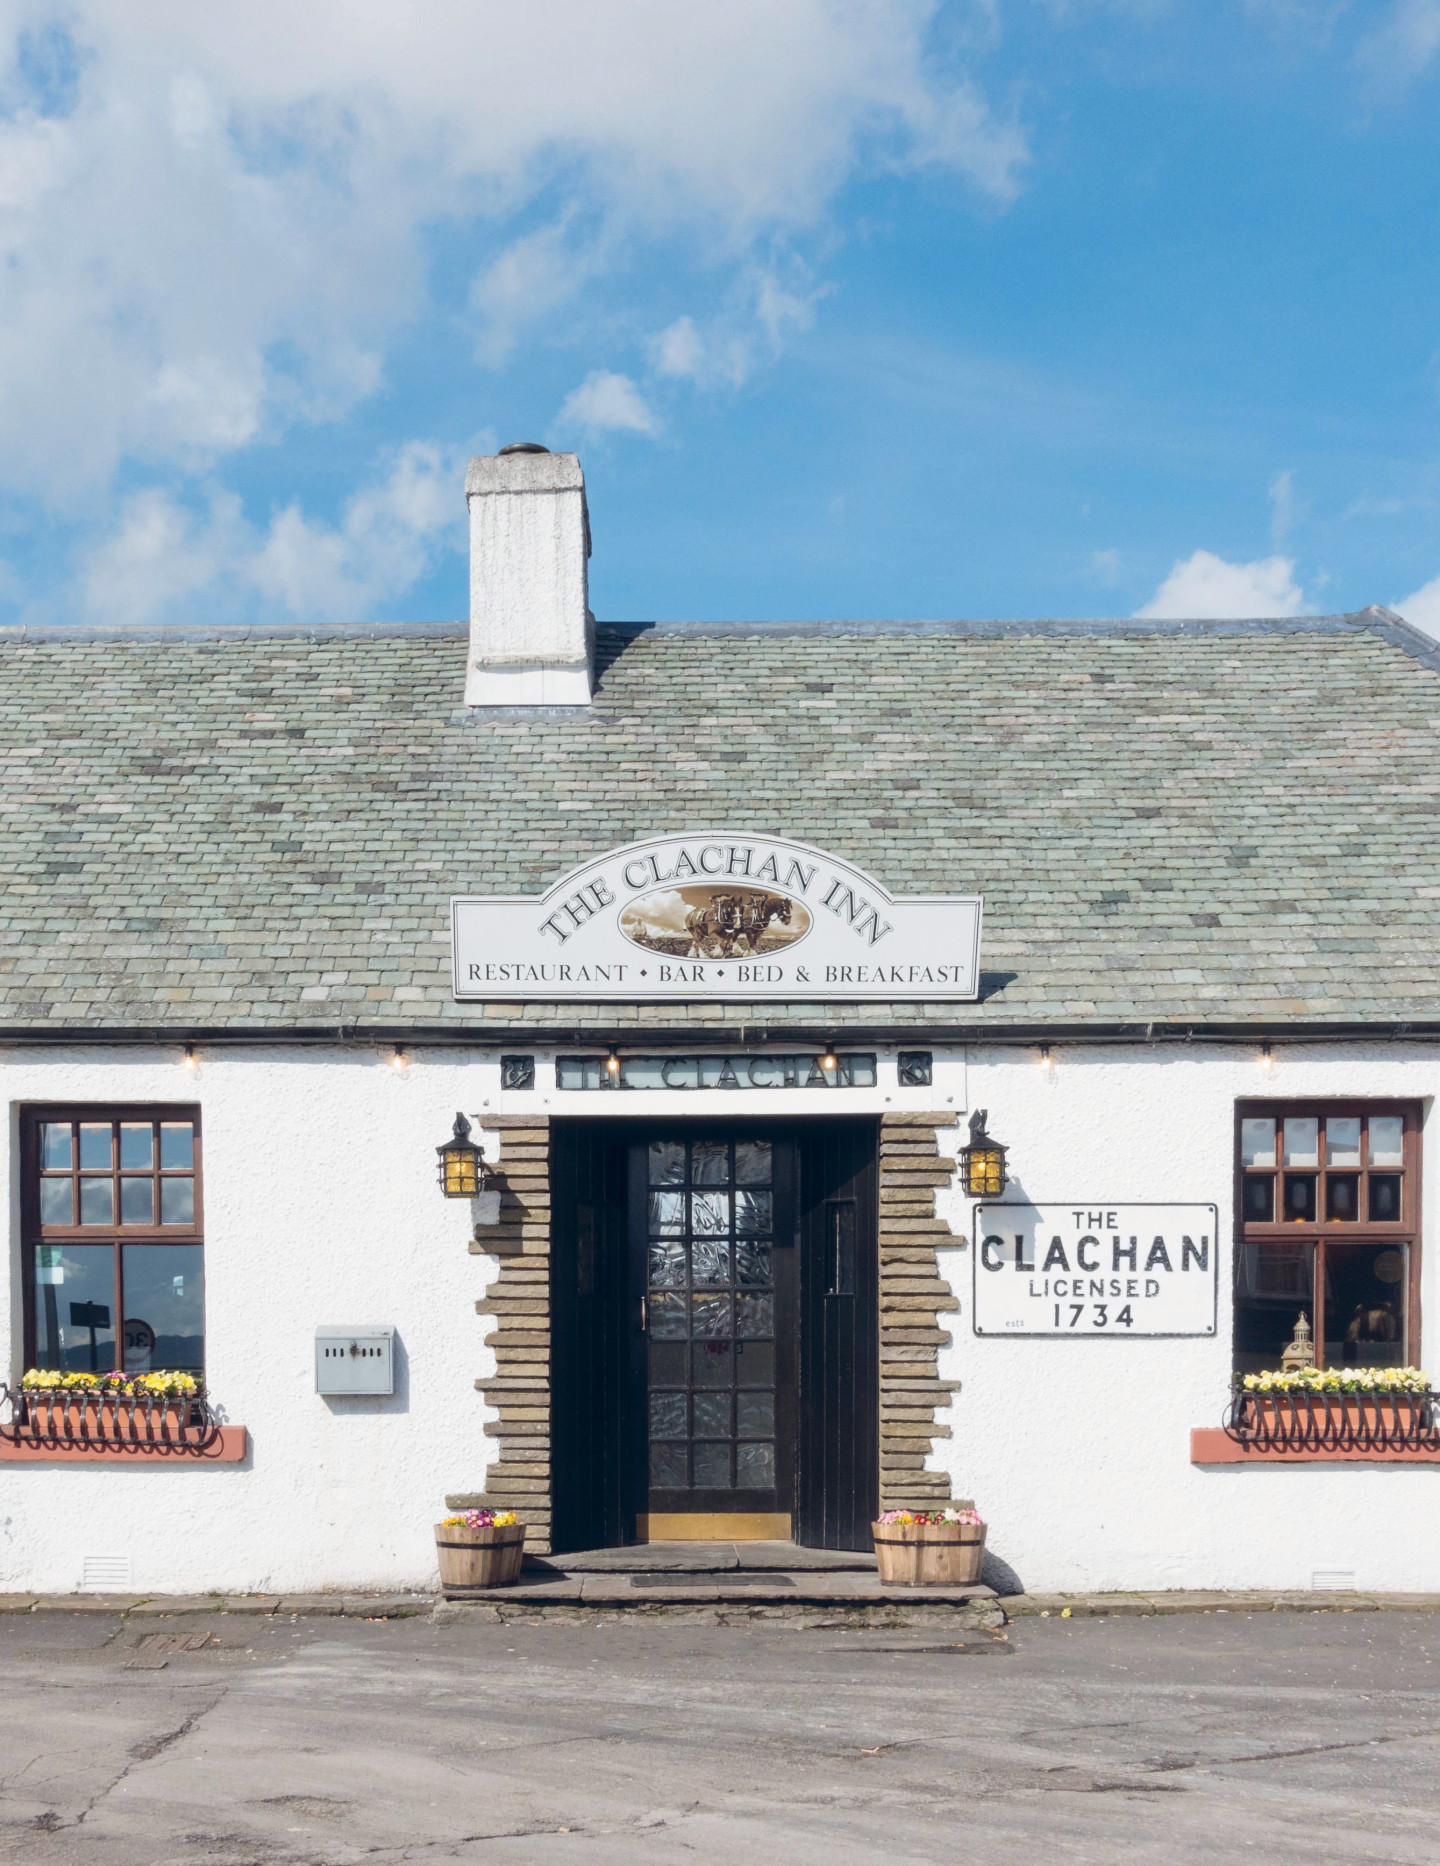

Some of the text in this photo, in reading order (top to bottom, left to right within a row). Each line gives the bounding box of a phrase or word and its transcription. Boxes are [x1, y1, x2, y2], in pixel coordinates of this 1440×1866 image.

[538, 845, 893, 947] THE CLACHAN INN
[468, 963, 965, 983] RESTAURANT BAR BED & BREAKFAST
[660, 1058, 854, 1089] CLACHAN
[1072, 1211, 1118, 1229] THE
[981, 1234, 1209, 1272] CLACHAN
[1029, 1279, 1161, 1298] LICENSED
[1054, 1303, 1134, 1328] 1734
